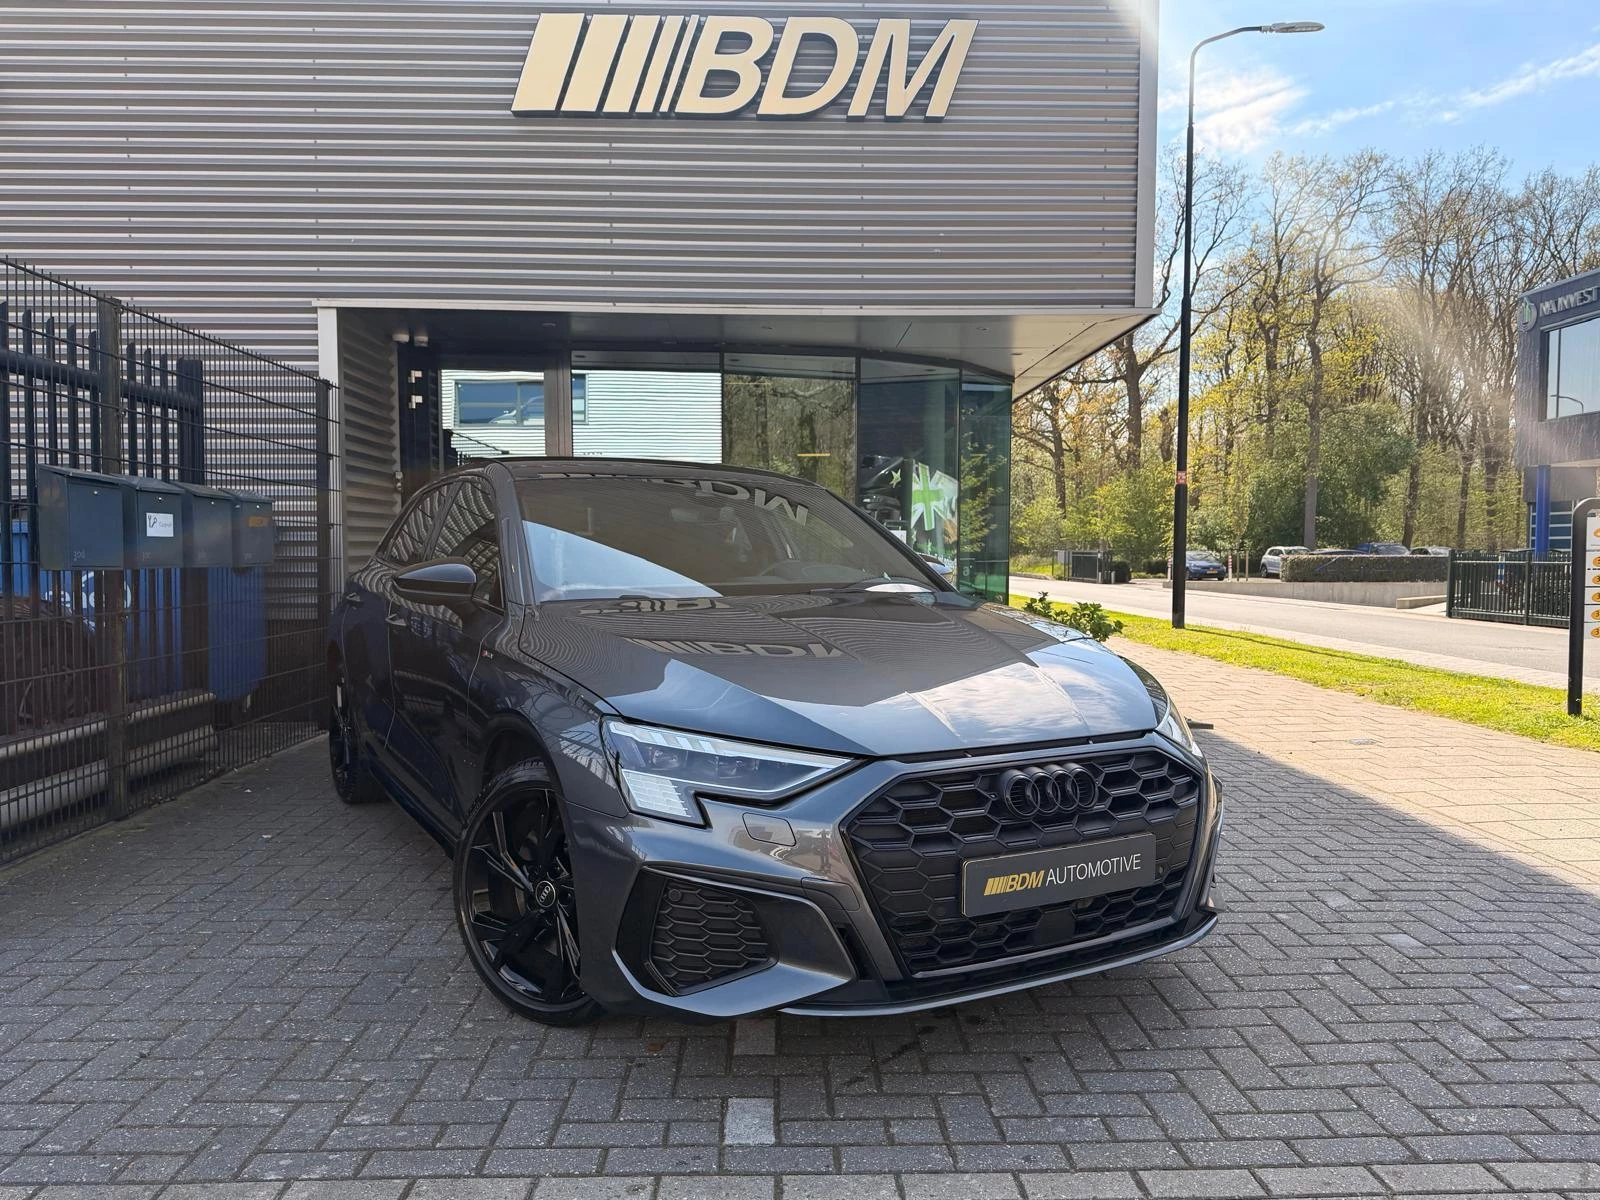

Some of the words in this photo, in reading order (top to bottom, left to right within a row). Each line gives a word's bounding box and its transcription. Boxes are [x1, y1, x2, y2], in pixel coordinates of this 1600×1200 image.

[674, 16, 979, 121] BDM
[1006, 870, 1045, 893] BDM
[1045, 853, 1141, 887] AUTOMOTIVE
